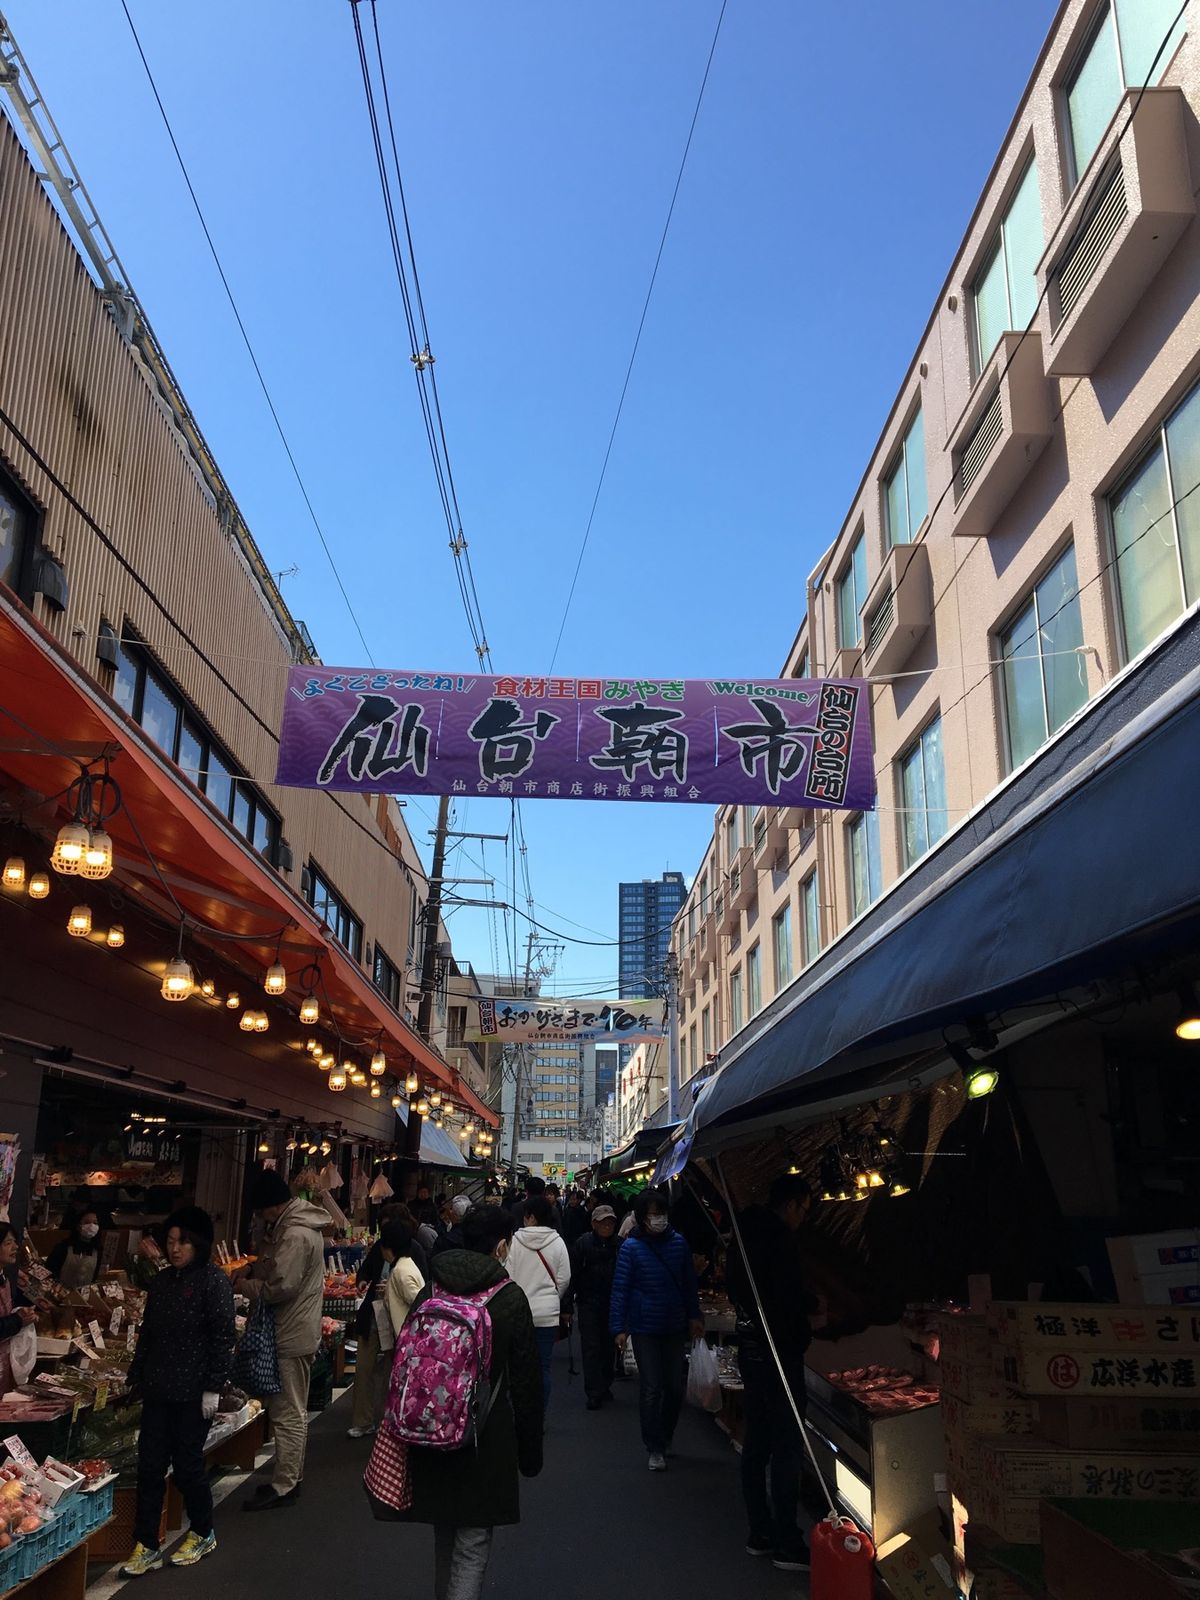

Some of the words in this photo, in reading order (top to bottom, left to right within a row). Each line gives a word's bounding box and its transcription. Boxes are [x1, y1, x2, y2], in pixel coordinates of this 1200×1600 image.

[493, 676, 685, 701] 食材王国みやぎ
[713, 680, 809, 703] Welcome
[316, 693, 822, 795] 仙台朝市
[813, 685, 855, 799] 仙台の台所
[451, 779, 702, 798] 仙台朝市商店街振興組合
[480, 1001, 495, 1034] 仙台朝市
[1034, 1314, 1102, 1338] 極洋
[1090, 1357, 1197, 1388] 広洋水産
